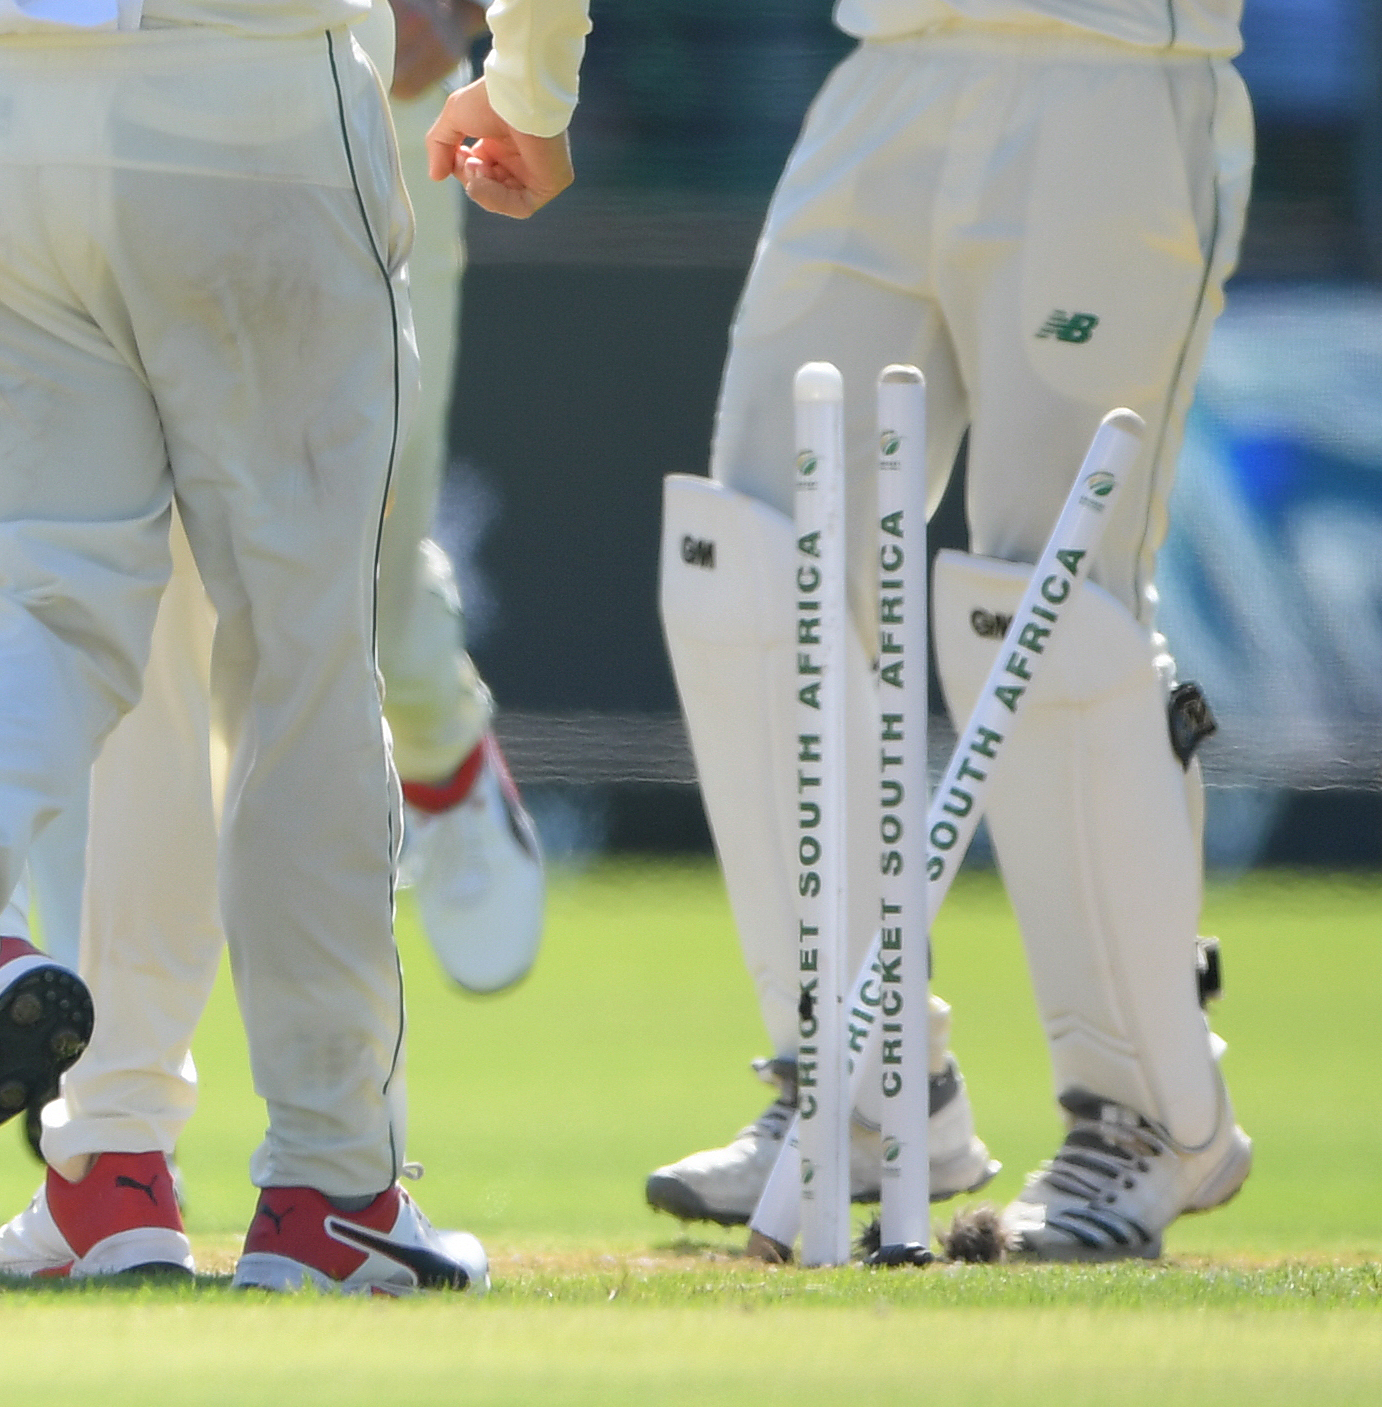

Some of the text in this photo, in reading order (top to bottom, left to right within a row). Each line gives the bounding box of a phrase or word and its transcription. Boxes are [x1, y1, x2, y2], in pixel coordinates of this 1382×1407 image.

[797, 530, 822, 1121] CRICKET SOUTH AFRICA
[880, 509, 905, 1098] CRICKET SOUTH AFRICA
[926, 546, 1087, 883] SOUTH AFRICA
